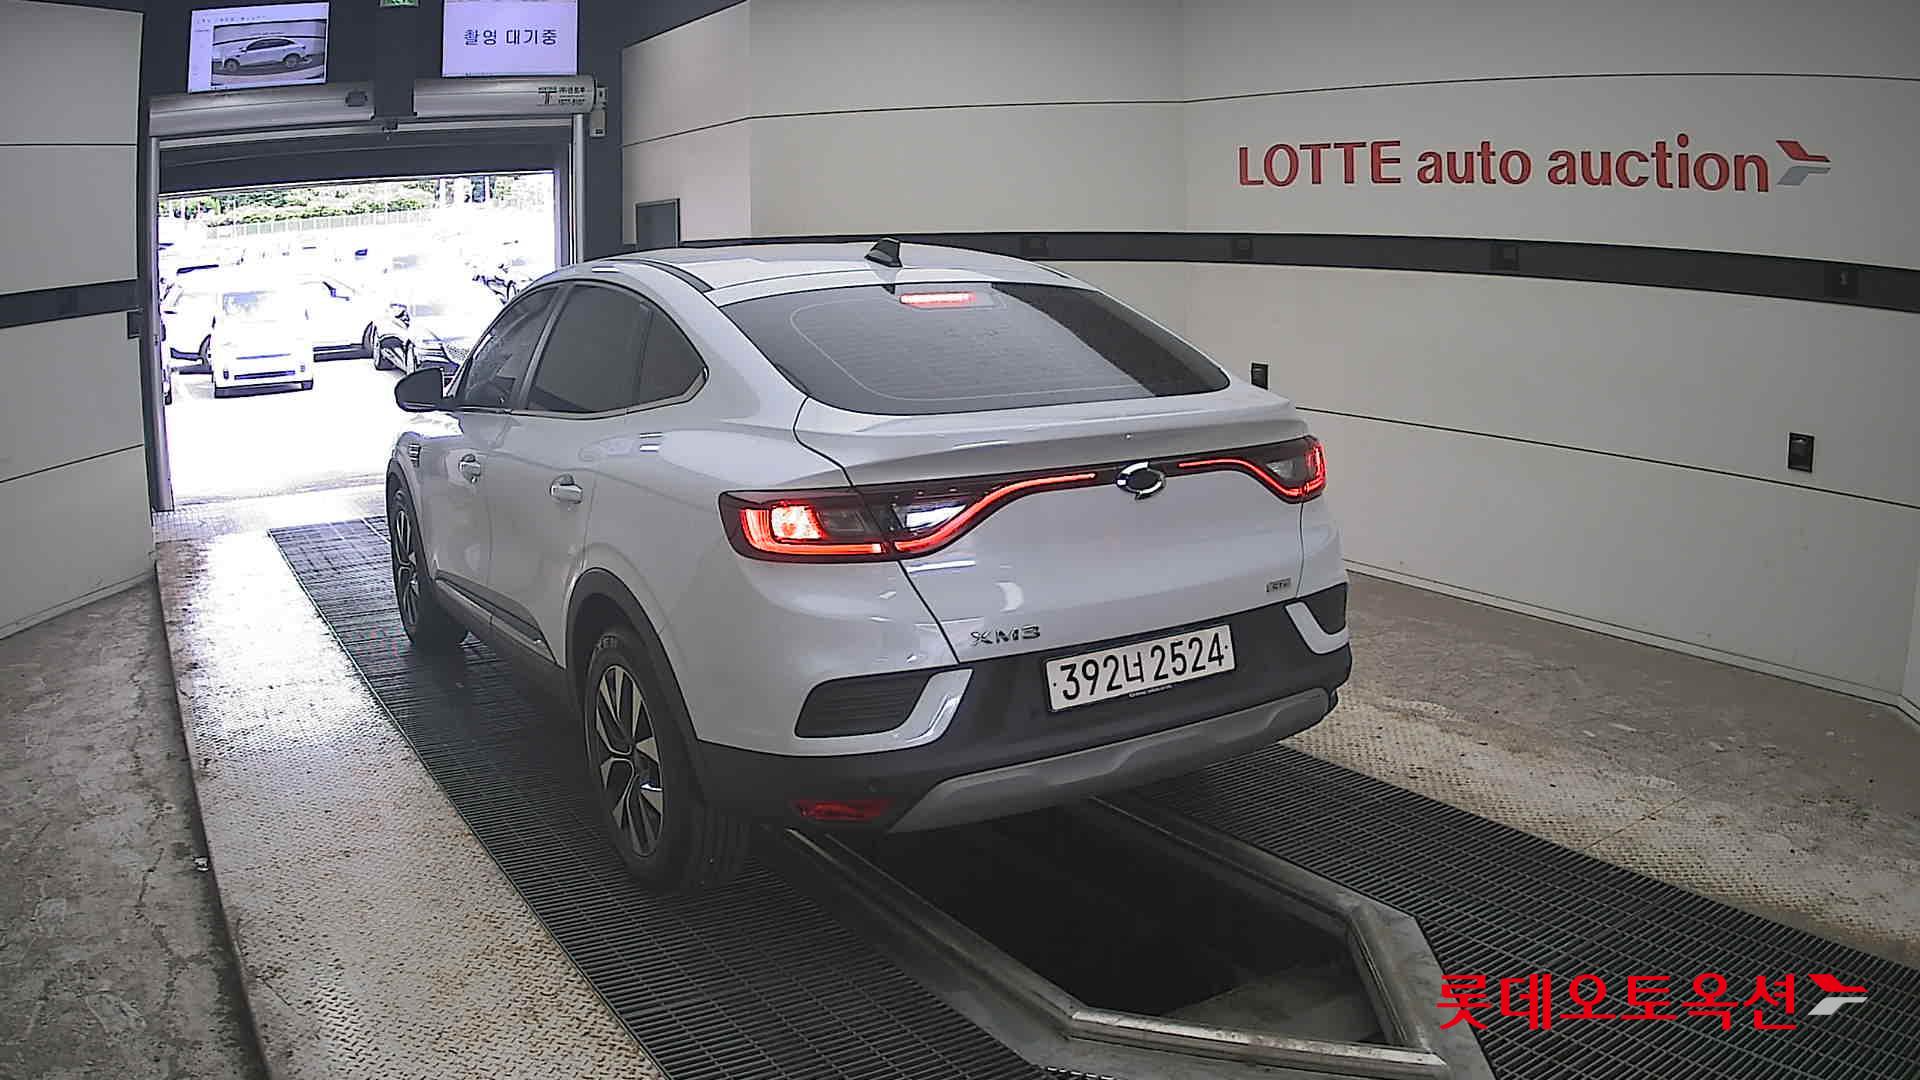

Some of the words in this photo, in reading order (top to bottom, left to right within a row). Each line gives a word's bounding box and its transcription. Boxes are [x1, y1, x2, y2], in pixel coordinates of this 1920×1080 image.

[506, 29, 558, 45] 대기중
[1238, 140, 1401, 186] LOTTE
[1416, 140, 1532, 185] auto
[1547, 133, 1770, 193] auction
[970, 625, 1040, 646] XM3
[1150, 632, 1225, 682] 2524
